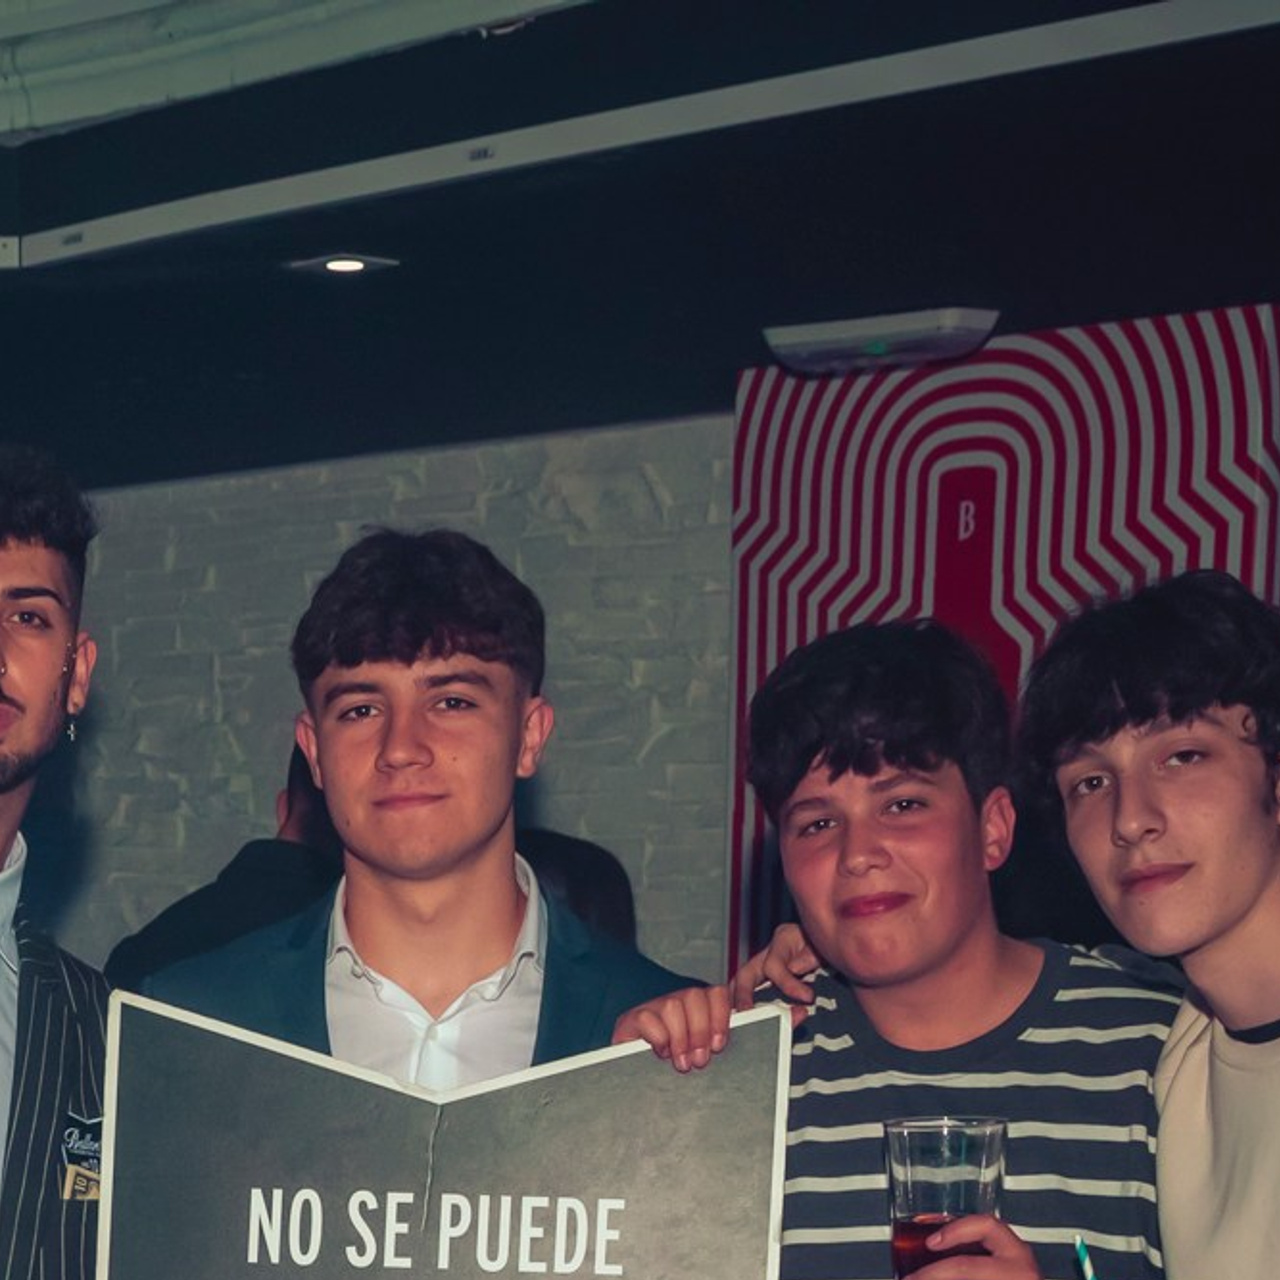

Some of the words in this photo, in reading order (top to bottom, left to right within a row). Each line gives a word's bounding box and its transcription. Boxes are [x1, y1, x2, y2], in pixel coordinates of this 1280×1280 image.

[959, 500, 976, 541] B
[248, 1188, 323, 1266] NO
[345, 1191, 414, 1269] SE
[437, 1194, 627, 1277] PUEDE
